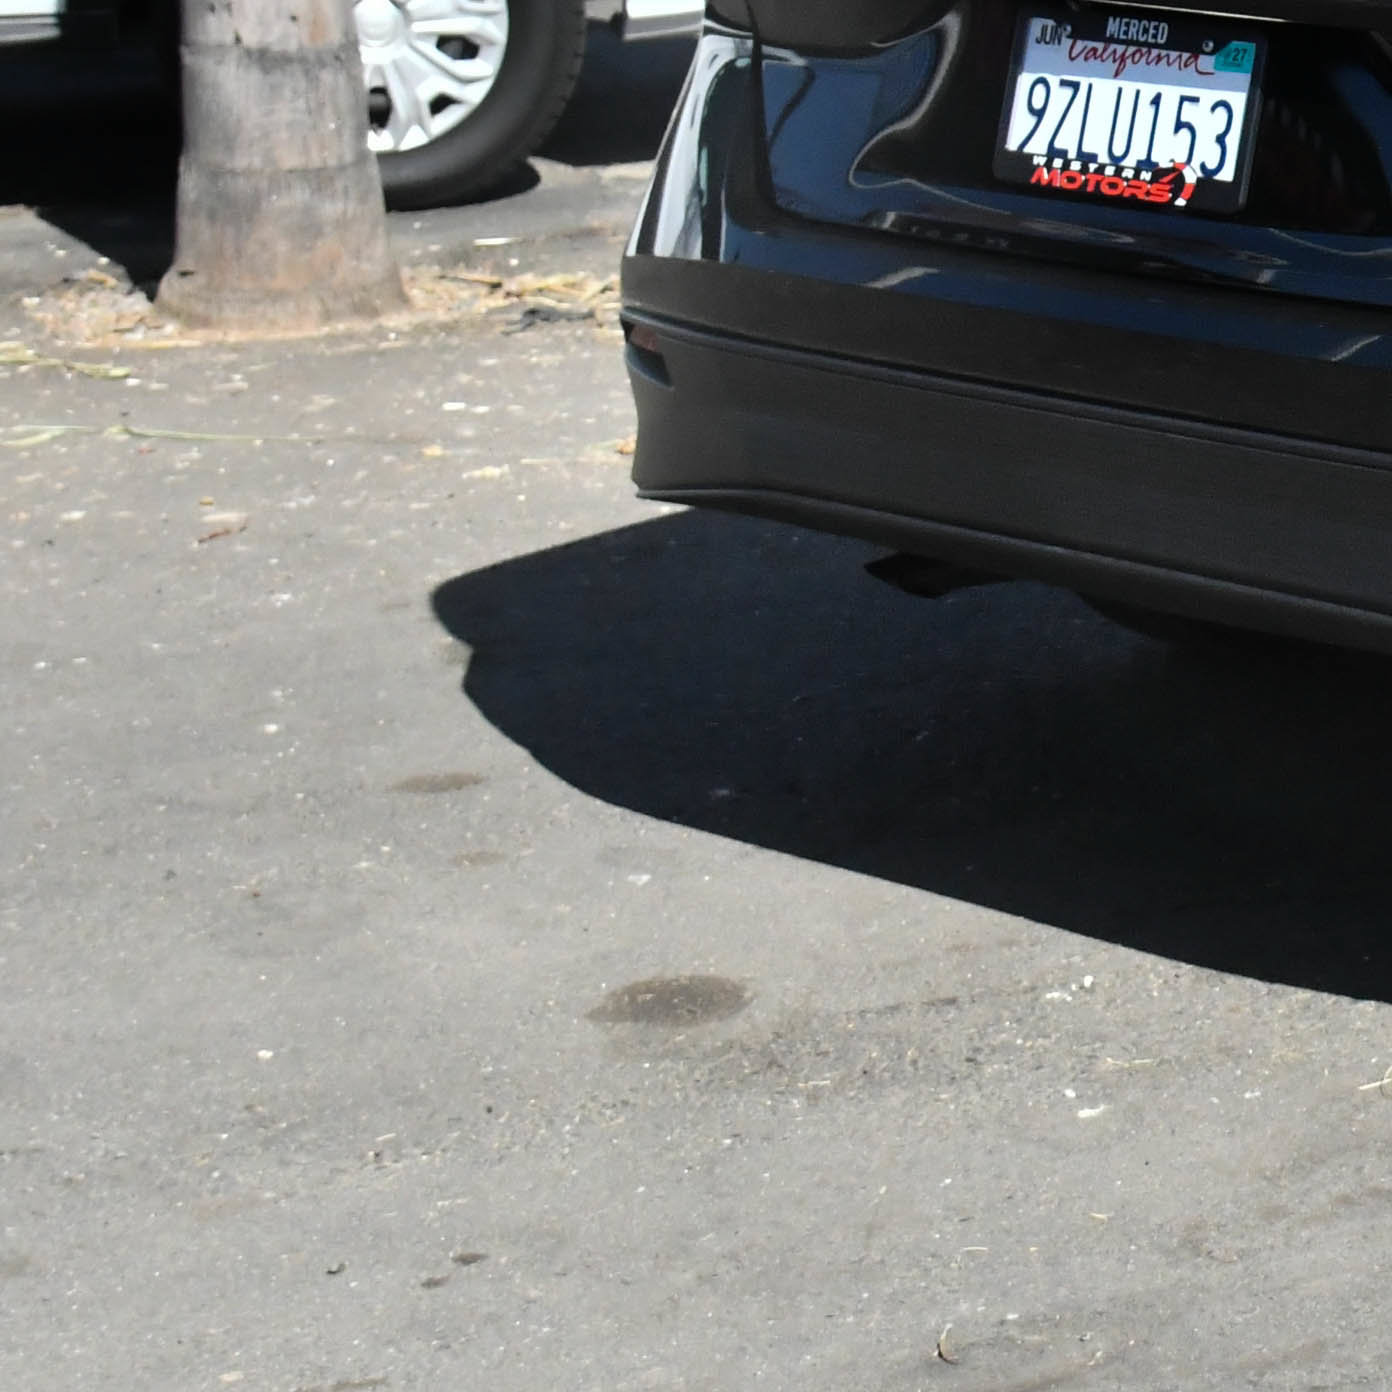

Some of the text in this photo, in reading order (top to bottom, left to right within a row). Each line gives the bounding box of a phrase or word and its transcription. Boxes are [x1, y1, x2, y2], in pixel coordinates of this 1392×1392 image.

[1106, 16, 1169, 44] MERCED
[1017, 75, 1234, 178] 9ZLU153
[1029, 165, 1172, 203] MOTORS
[1032, 155, 1152, 181] WESTERN
